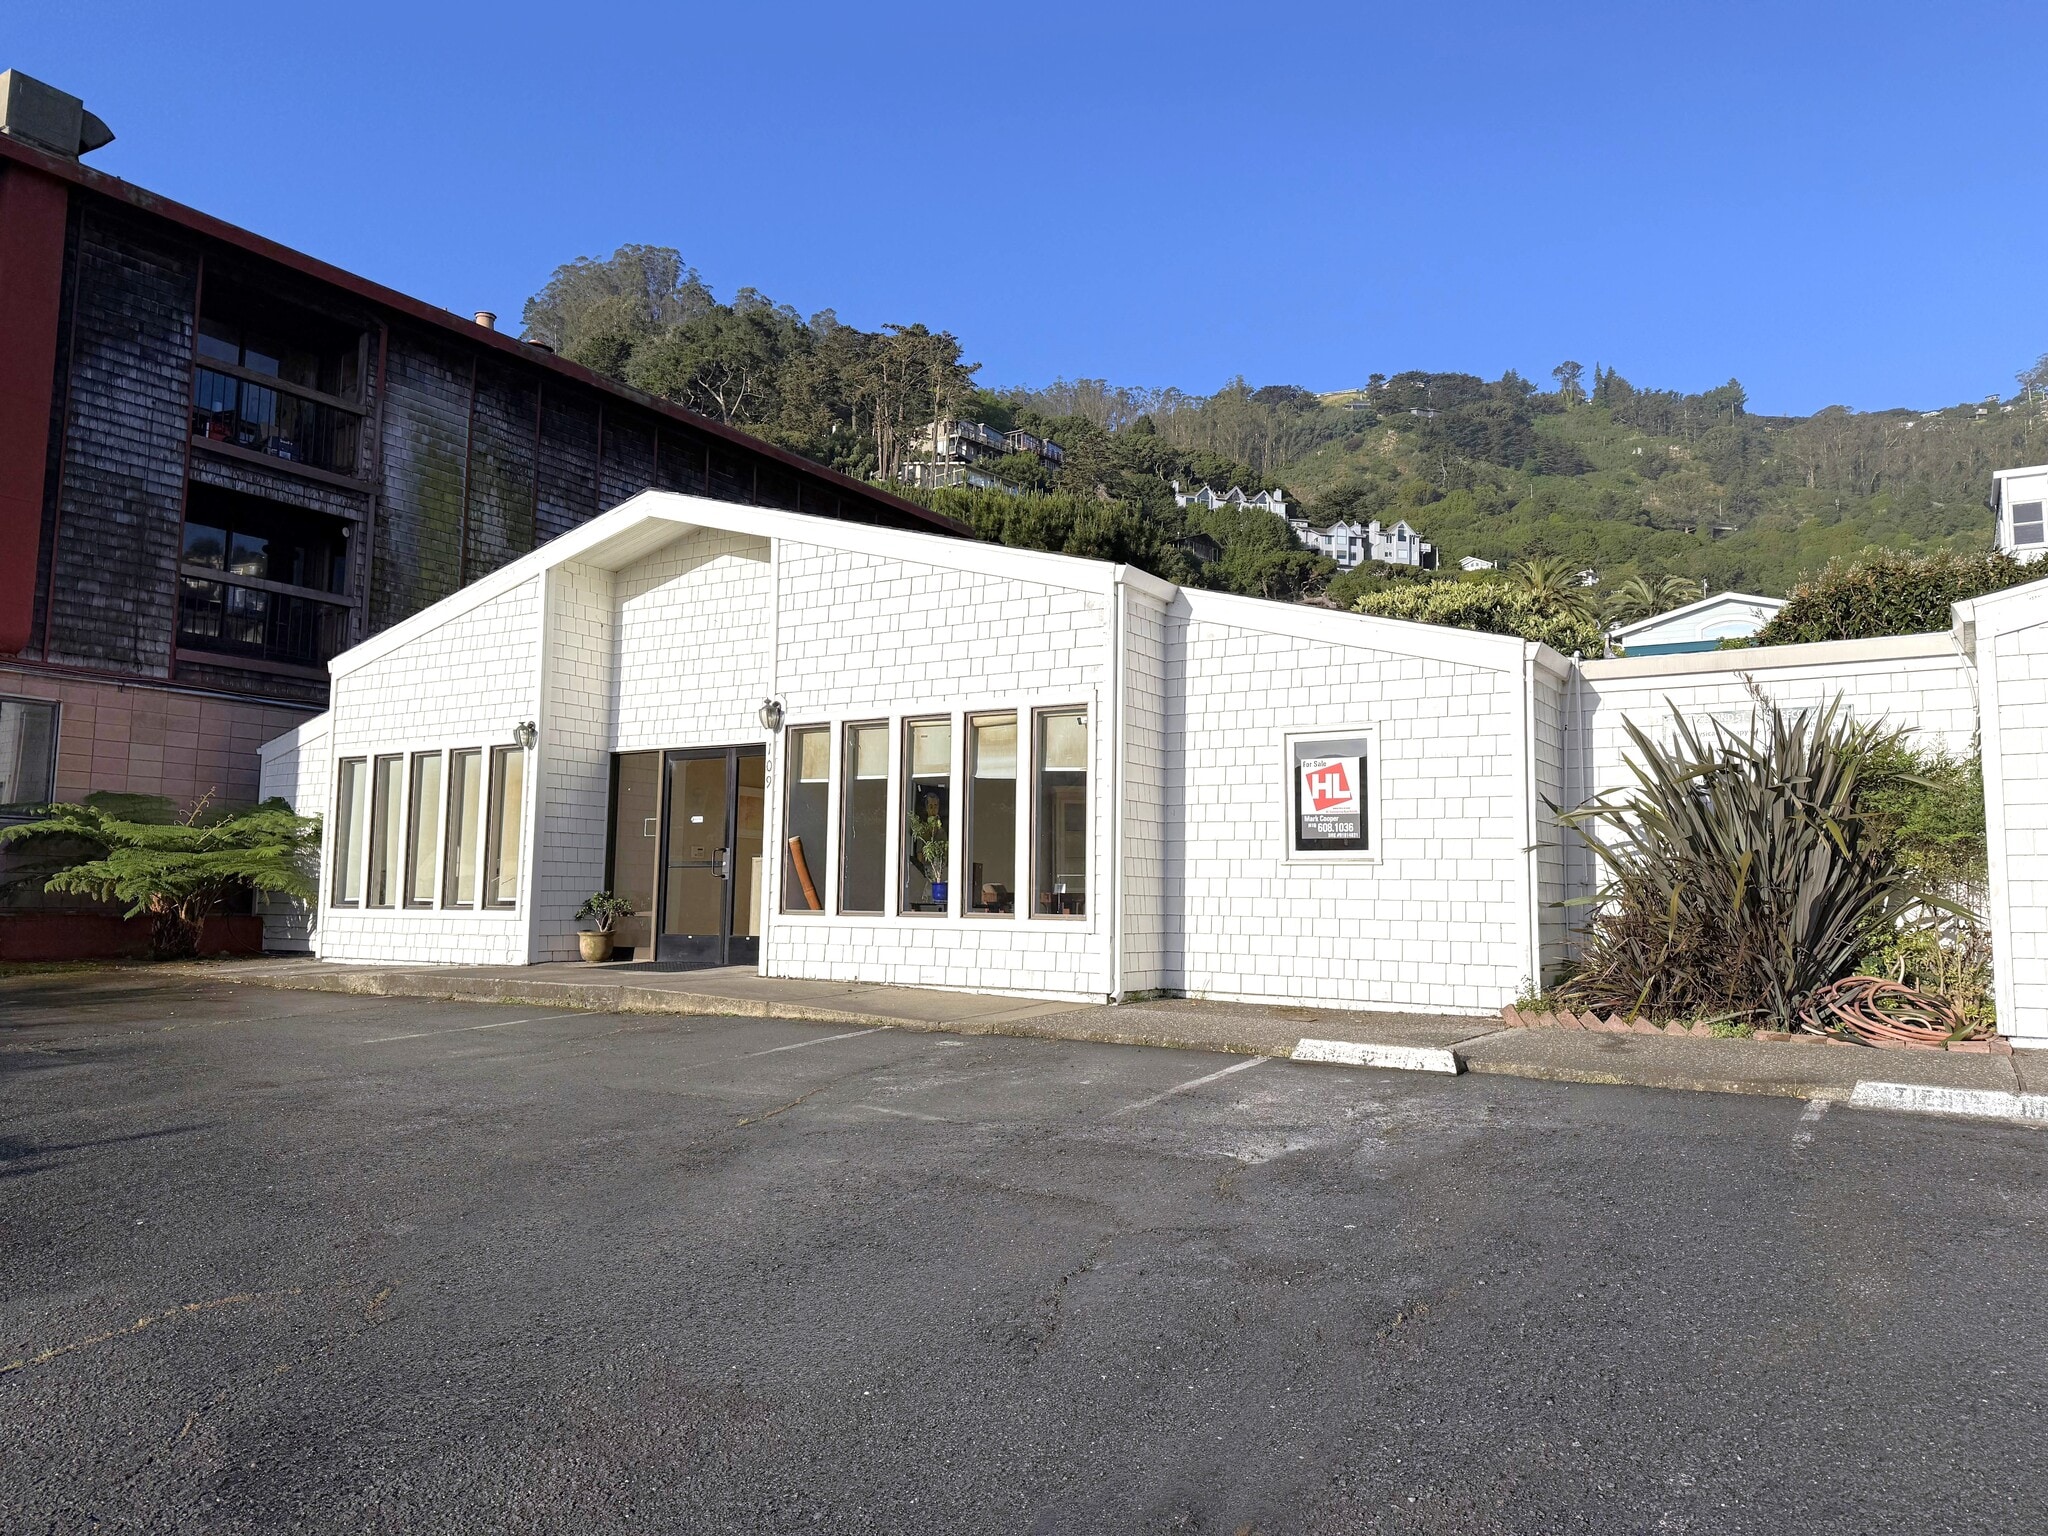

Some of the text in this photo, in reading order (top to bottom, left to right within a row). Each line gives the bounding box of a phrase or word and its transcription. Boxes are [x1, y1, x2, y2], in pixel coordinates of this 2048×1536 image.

[1303, 760, 1327, 768] For Sale
[1312, 773, 1351, 799] HL
[1317, 822, 1354, 833] 608.1036
